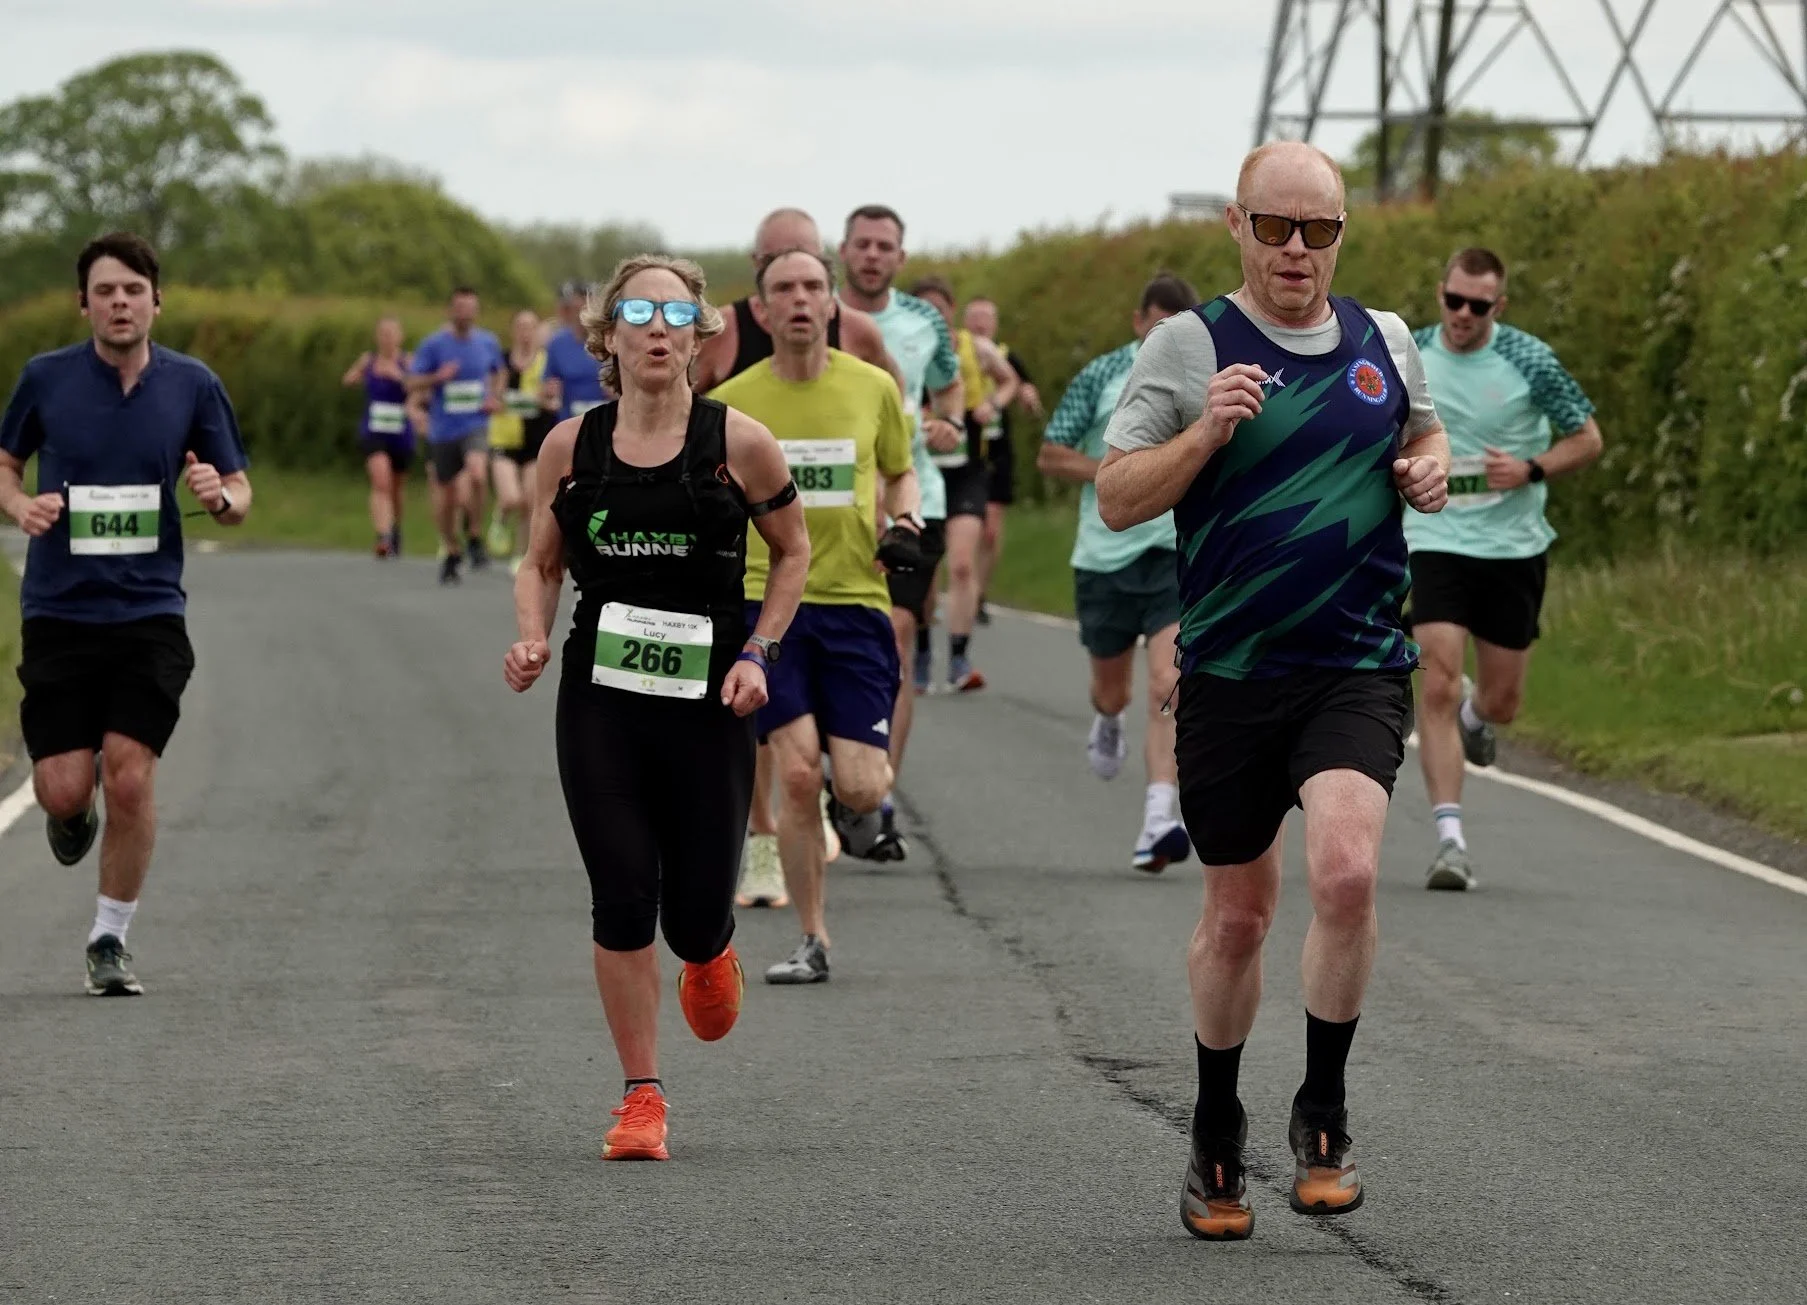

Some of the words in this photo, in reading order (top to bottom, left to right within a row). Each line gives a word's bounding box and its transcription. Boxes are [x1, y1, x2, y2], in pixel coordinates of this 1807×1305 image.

[91, 512, 139, 536] 644
[596, 543, 693, 557] RUNNE
[643, 628, 667, 640] Lucy
[620, 640, 683, 675] 266
